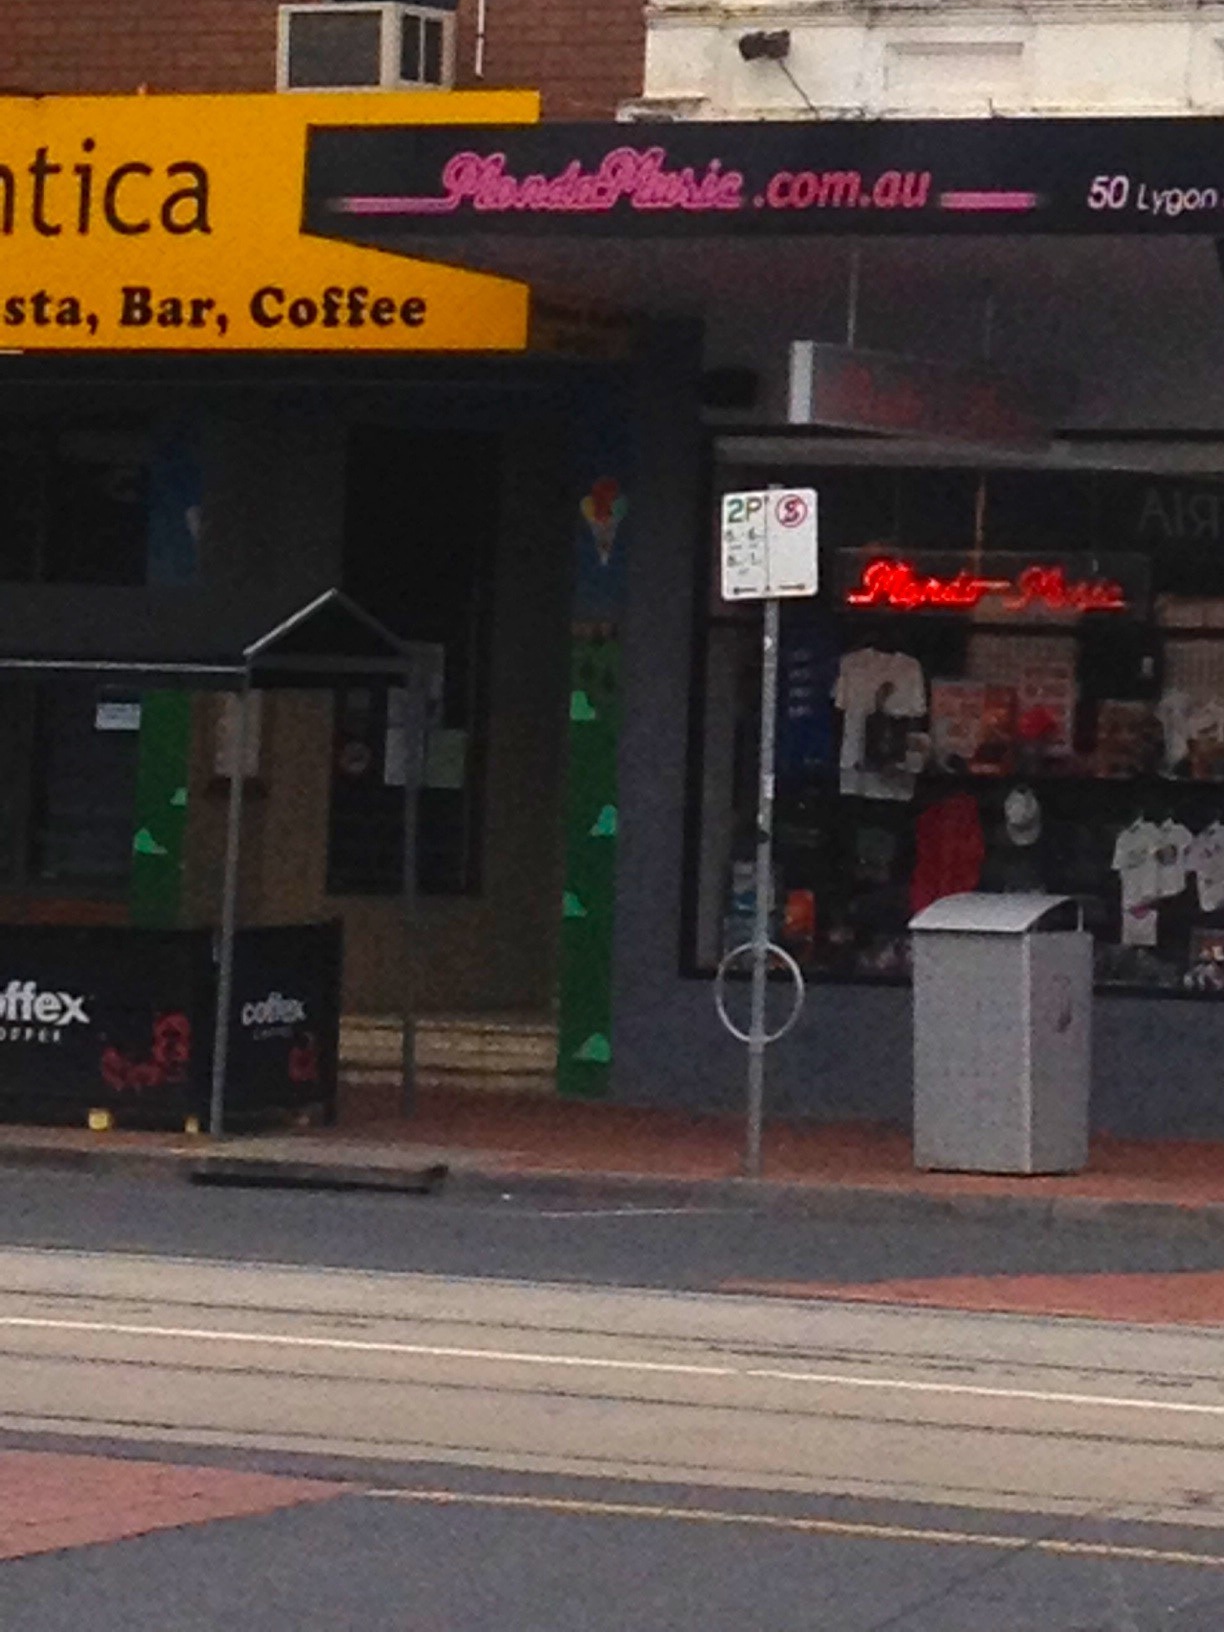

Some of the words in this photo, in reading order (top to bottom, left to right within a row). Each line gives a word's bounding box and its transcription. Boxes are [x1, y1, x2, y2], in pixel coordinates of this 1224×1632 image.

[1087, 175, 1130, 209] 50
[1137, 183, 1218, 216] Lygon
[119, 286, 228, 336] Bar,
[250, 286, 427, 328] Coffee
[727, 496, 762, 523] 2P
